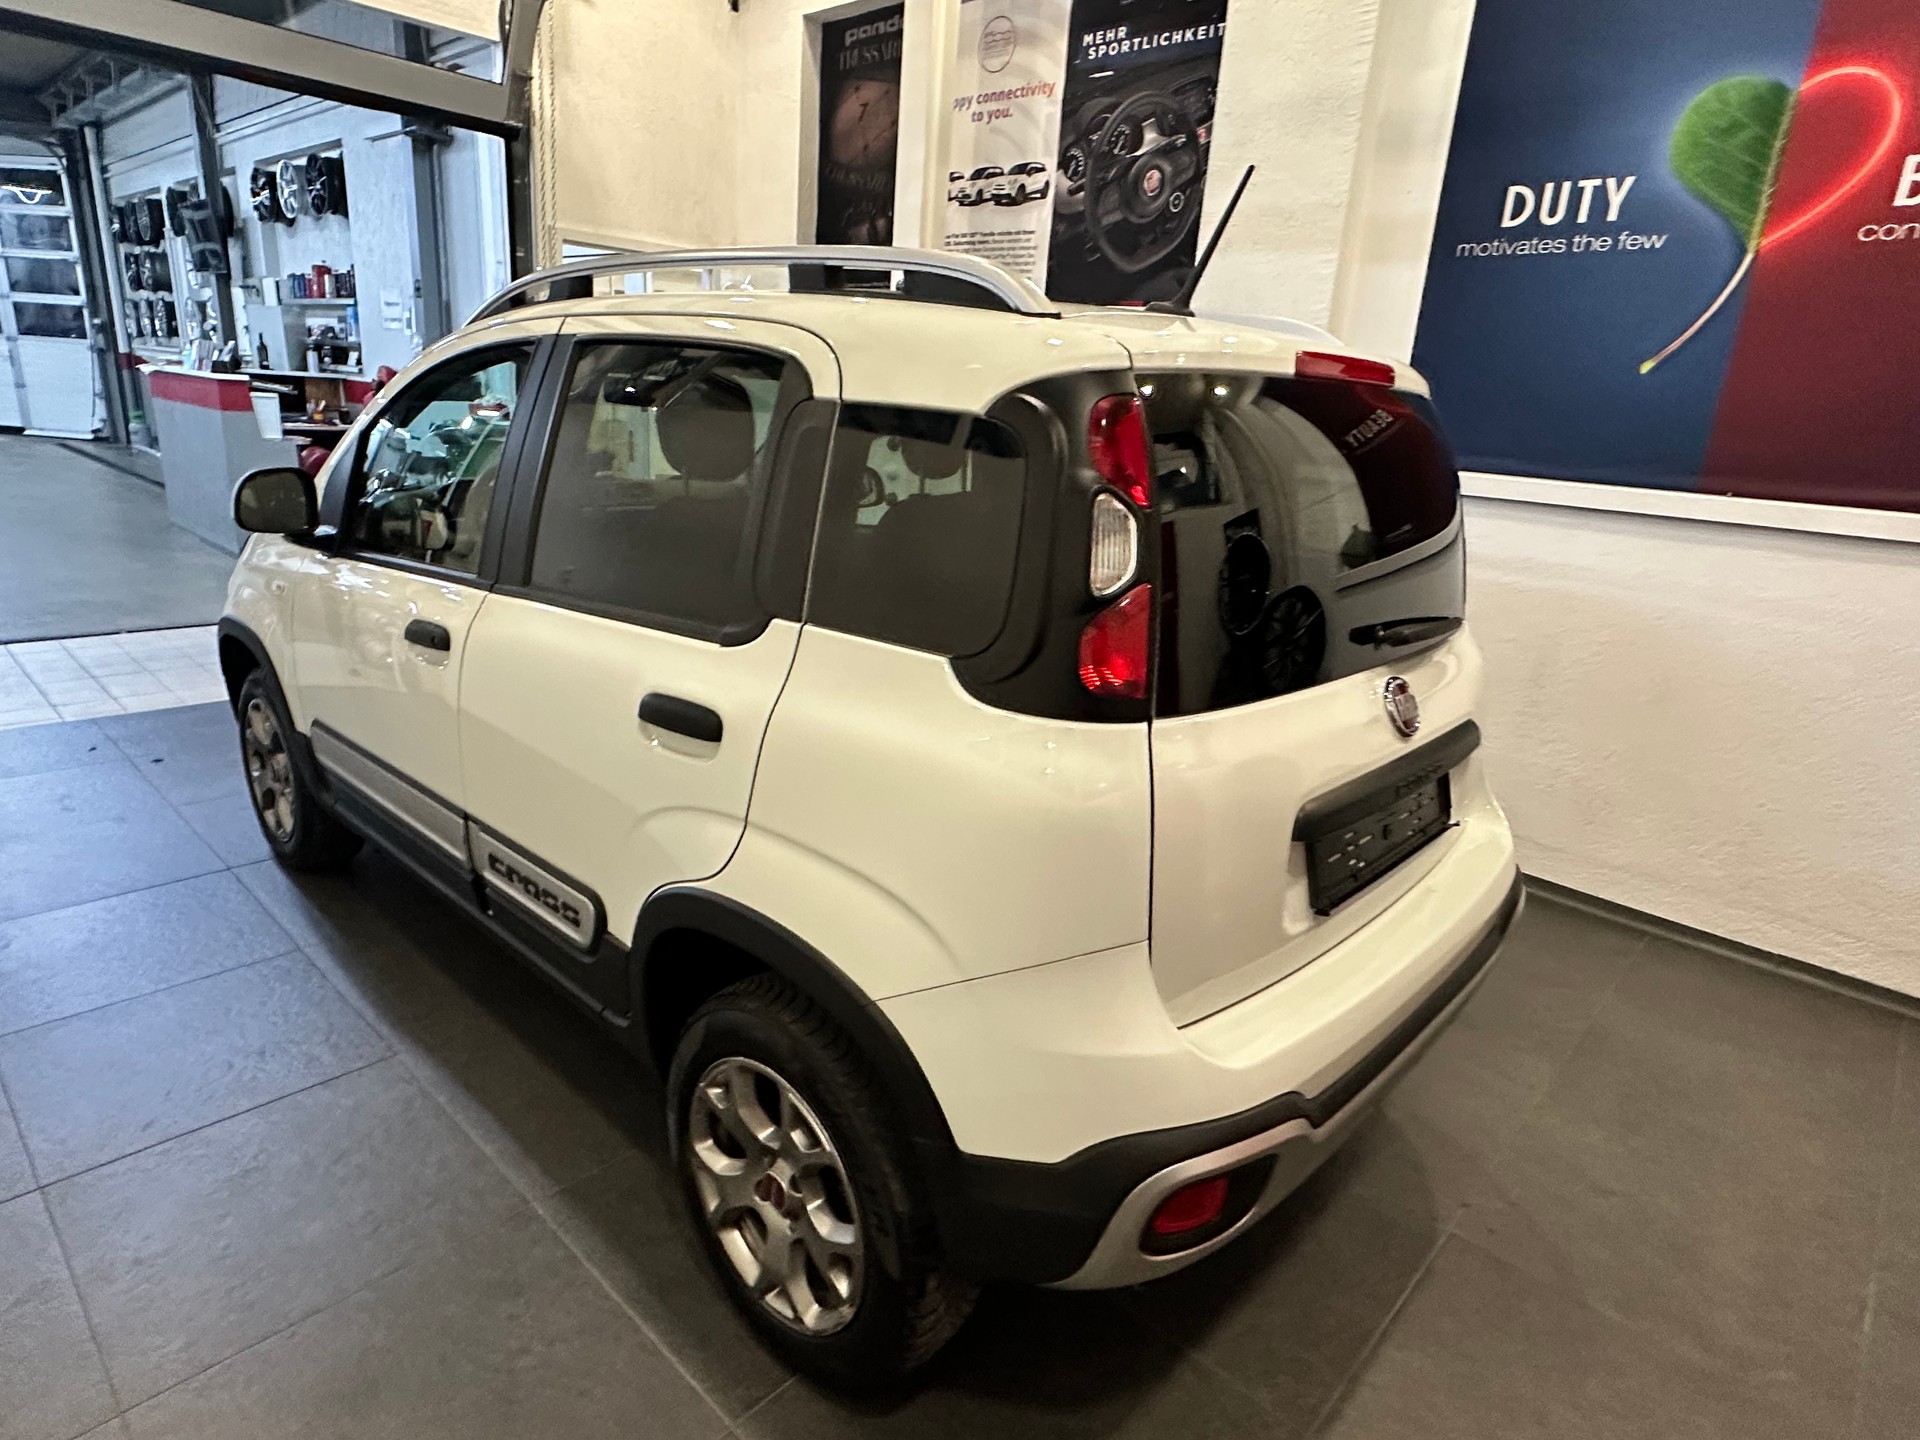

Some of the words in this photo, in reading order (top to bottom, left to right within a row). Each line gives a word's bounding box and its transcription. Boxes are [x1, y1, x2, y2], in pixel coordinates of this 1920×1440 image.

[844, 14, 902, 47] pand
[1082, 26, 1128, 47] MEHR
[1088, 23, 1227, 60] SPORTLICHKEIT
[976, 82, 1056, 105] connectivity
[971, 110, 984, 123] to
[986, 107, 1014, 125] you.
[1500, 175, 1637, 228] DUTY
[1456, 236, 1567, 258] motivates
[1572, 234, 1613, 252] the
[1617, 230, 1669, 250] few
[488, 853, 581, 929] CROSS
